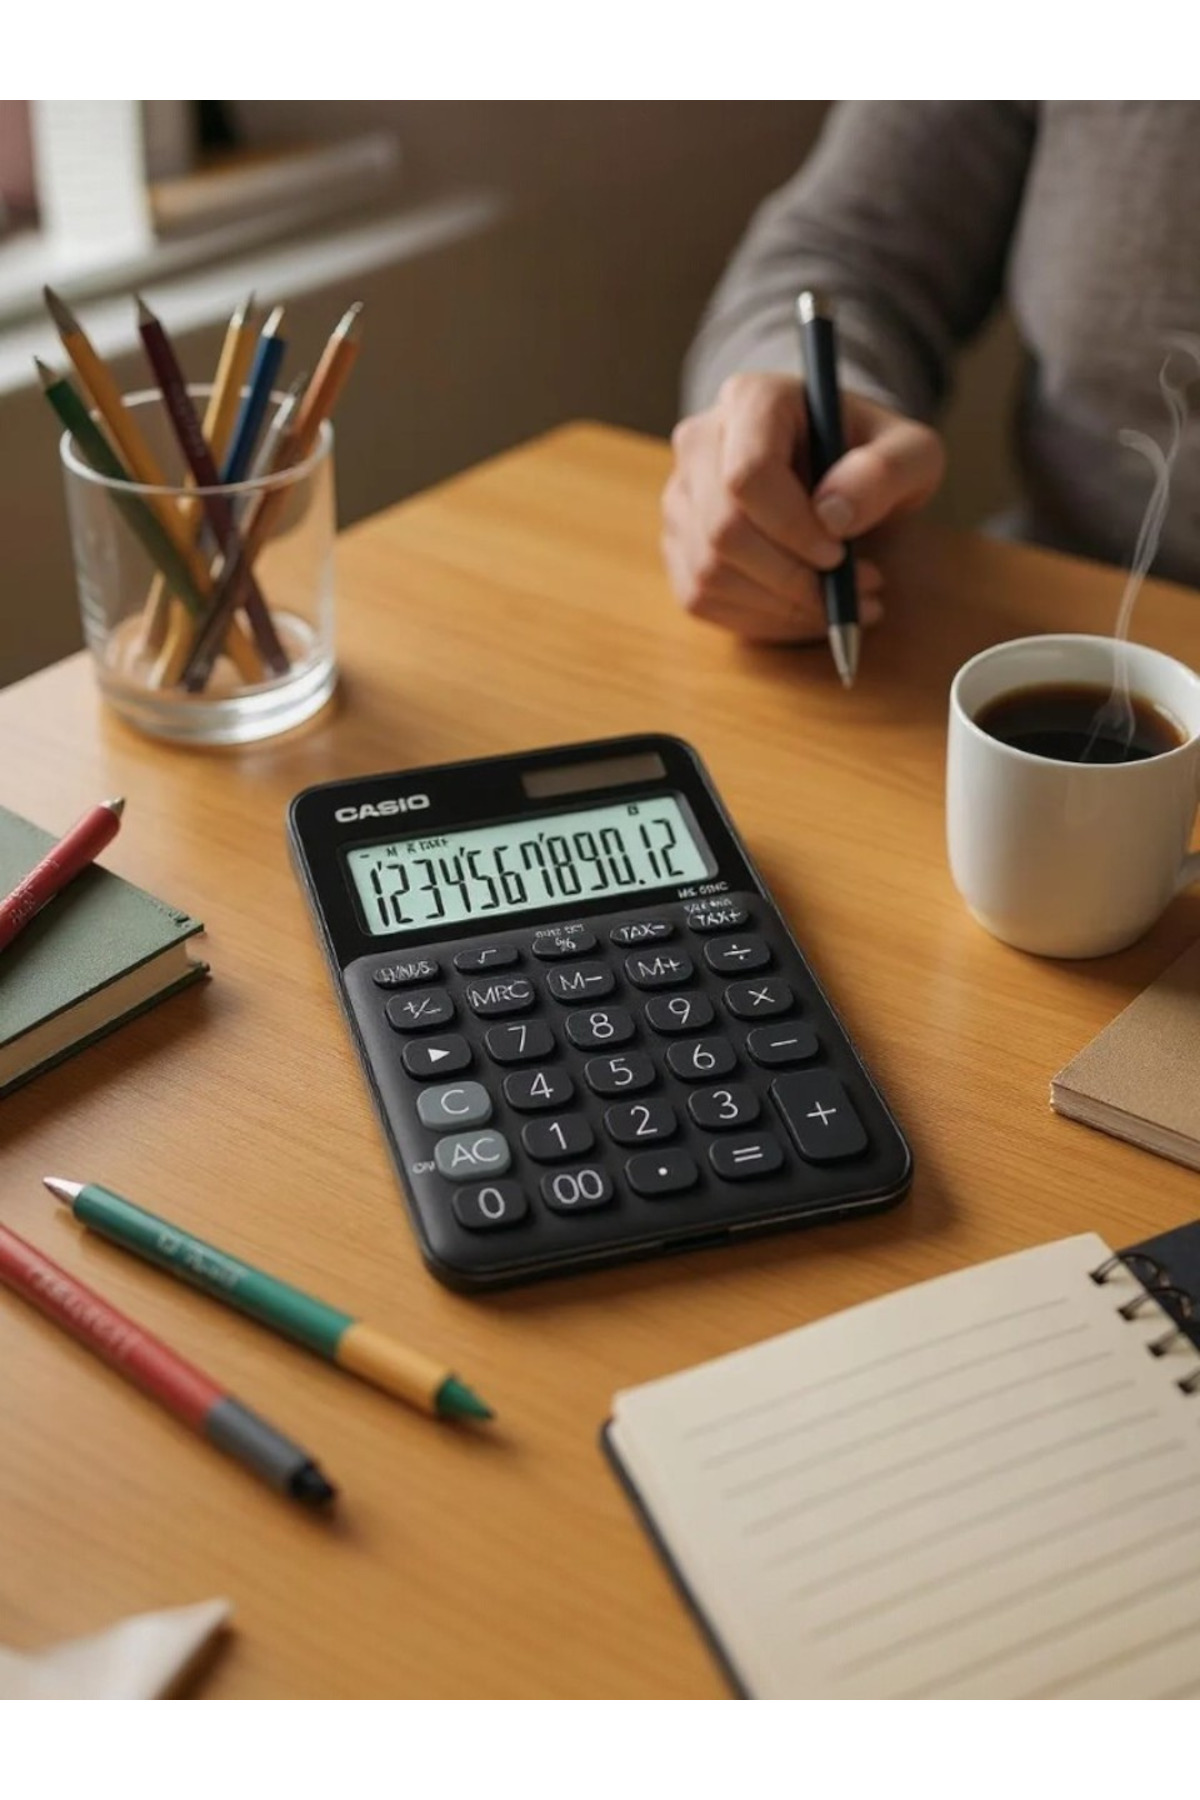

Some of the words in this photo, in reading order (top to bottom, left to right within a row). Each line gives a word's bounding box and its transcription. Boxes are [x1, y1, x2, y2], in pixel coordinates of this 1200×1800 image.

[335, 794, 430, 823] CASIO
[638, 957, 680, 977] M+
[471, 980, 529, 1007] MRC
[668, 997, 691, 1024] 9
[507, 1025, 526, 1053] 7
[589, 1012, 614, 1039] 8
[693, 1043, 716, 1070] 6
[529, 1072, 554, 1099] 4
[609, 1057, 633, 1086] 5
[440, 1089, 470, 1115] C
[712, 1091, 739, 1119] 3
[630, 1105, 658, 1135] 2
[549, 1122, 567, 1150] 1
[451, 1137, 500, 1168] AC
[552, 1169, 604, 1204] 00
[478, 1187, 505, 1219] 0
